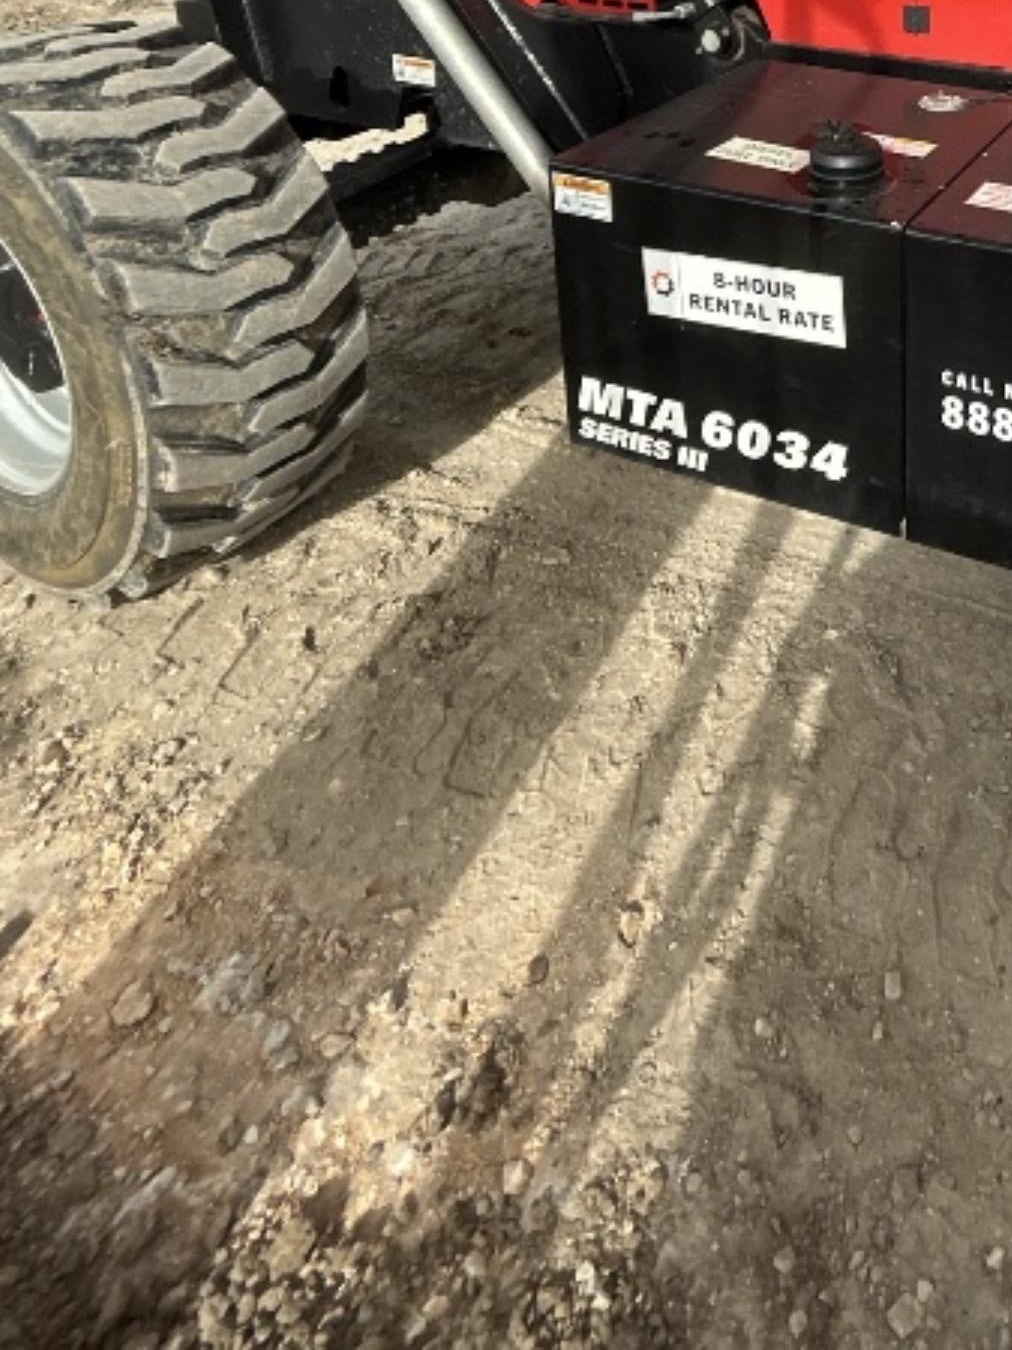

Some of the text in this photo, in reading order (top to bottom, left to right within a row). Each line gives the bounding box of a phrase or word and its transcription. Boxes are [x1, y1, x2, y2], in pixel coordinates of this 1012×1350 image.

[713, 271, 797, 301] 8-HOUR
[689, 293, 835, 333] RENTAL RATE
[941, 368, 994, 397] CALL
[578, 375, 849, 482] MTA 6034
[578, 416, 673, 461] SERIES
